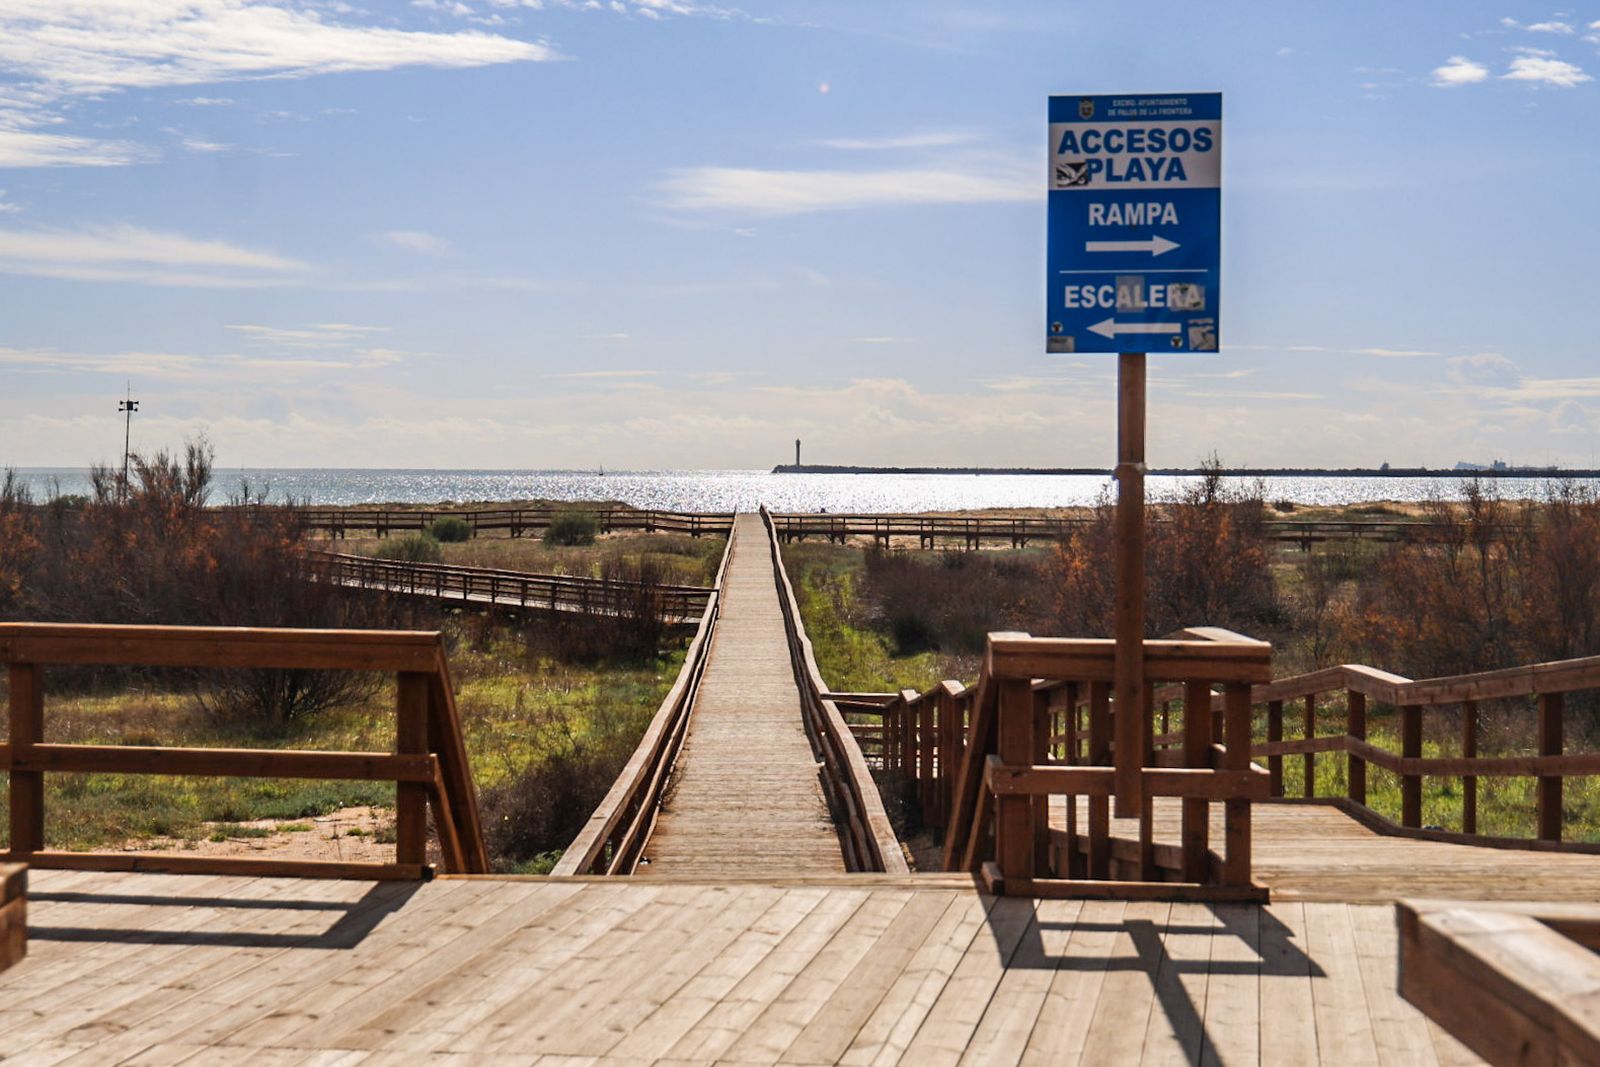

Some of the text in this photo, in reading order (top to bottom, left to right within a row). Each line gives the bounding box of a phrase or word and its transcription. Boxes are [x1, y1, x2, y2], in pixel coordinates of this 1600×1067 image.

[1107, 109, 1116, 117] DE
[1149, 108, 1157, 116] LA
[1138, 98, 1188, 106] AYUNTAMIENTO
[1057, 127, 1213, 154] ACCESOS
[1086, 157, 1187, 182] PLAYA
[1088, 203, 1179, 226] RAMPA
[1064, 284, 1202, 308] ESCALERA
